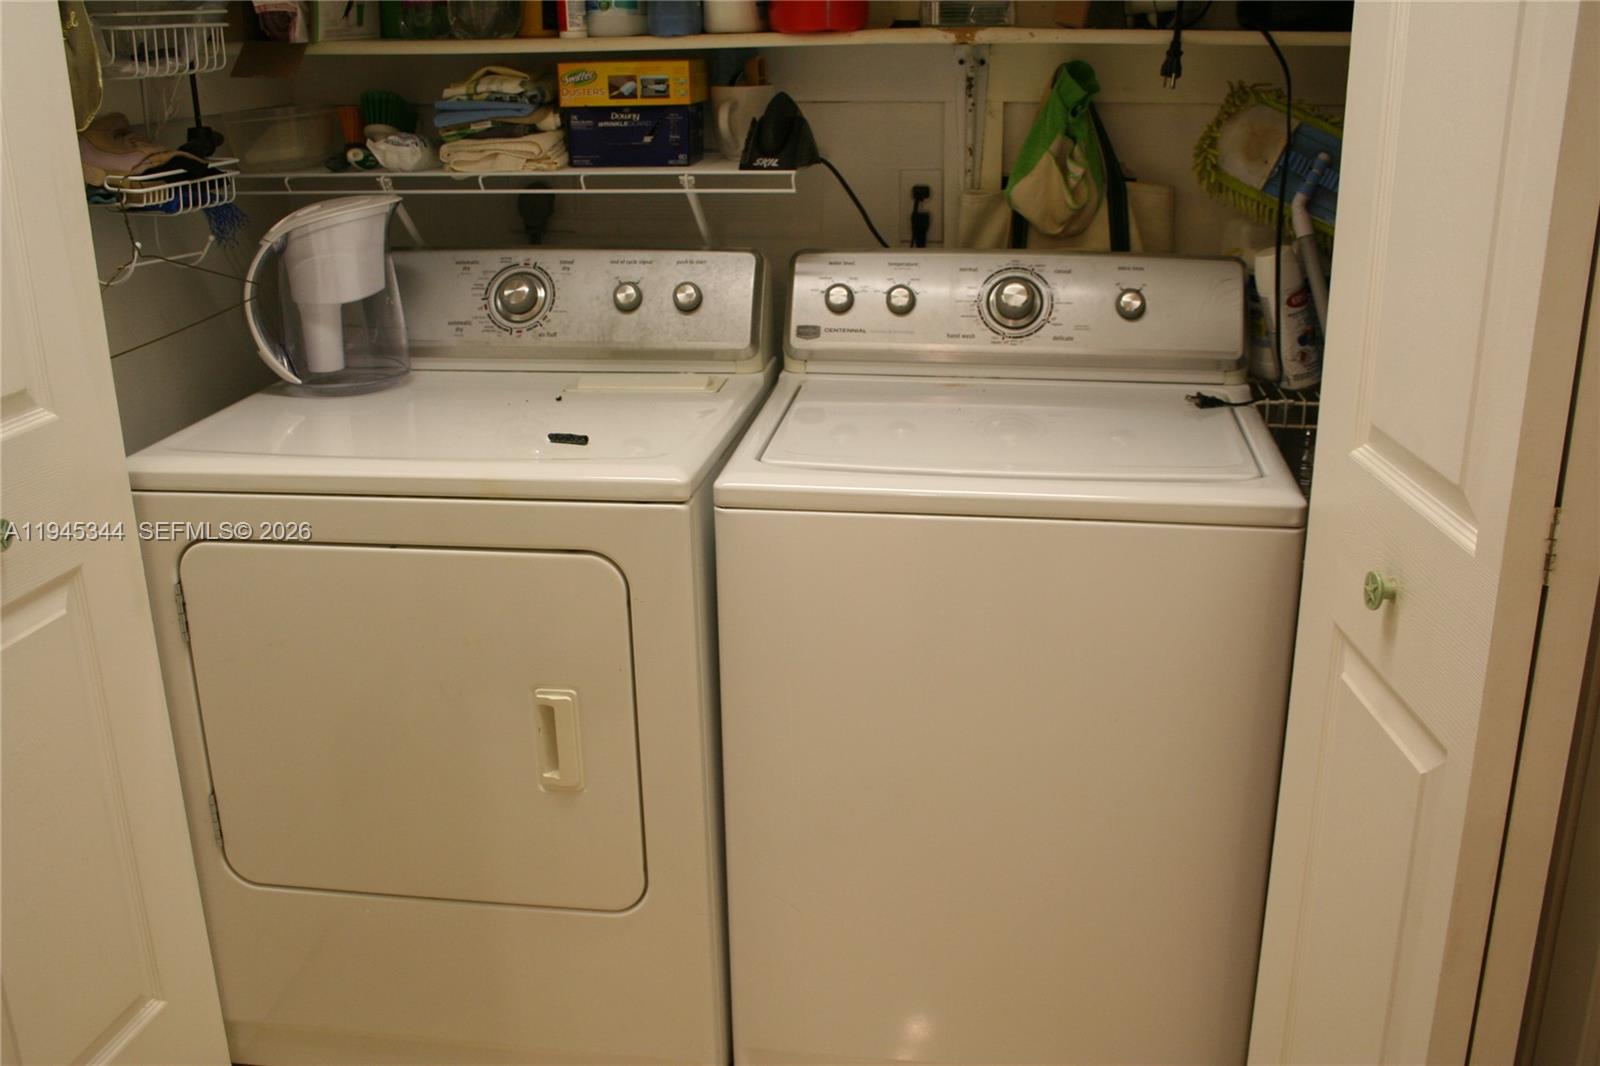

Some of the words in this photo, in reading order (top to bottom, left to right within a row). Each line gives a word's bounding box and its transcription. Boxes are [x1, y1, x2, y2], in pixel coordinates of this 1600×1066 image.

[562, 88, 606, 97] DUSTERS
[610, 112, 641, 121] Downy
[752, 157, 780, 168] SKIL
